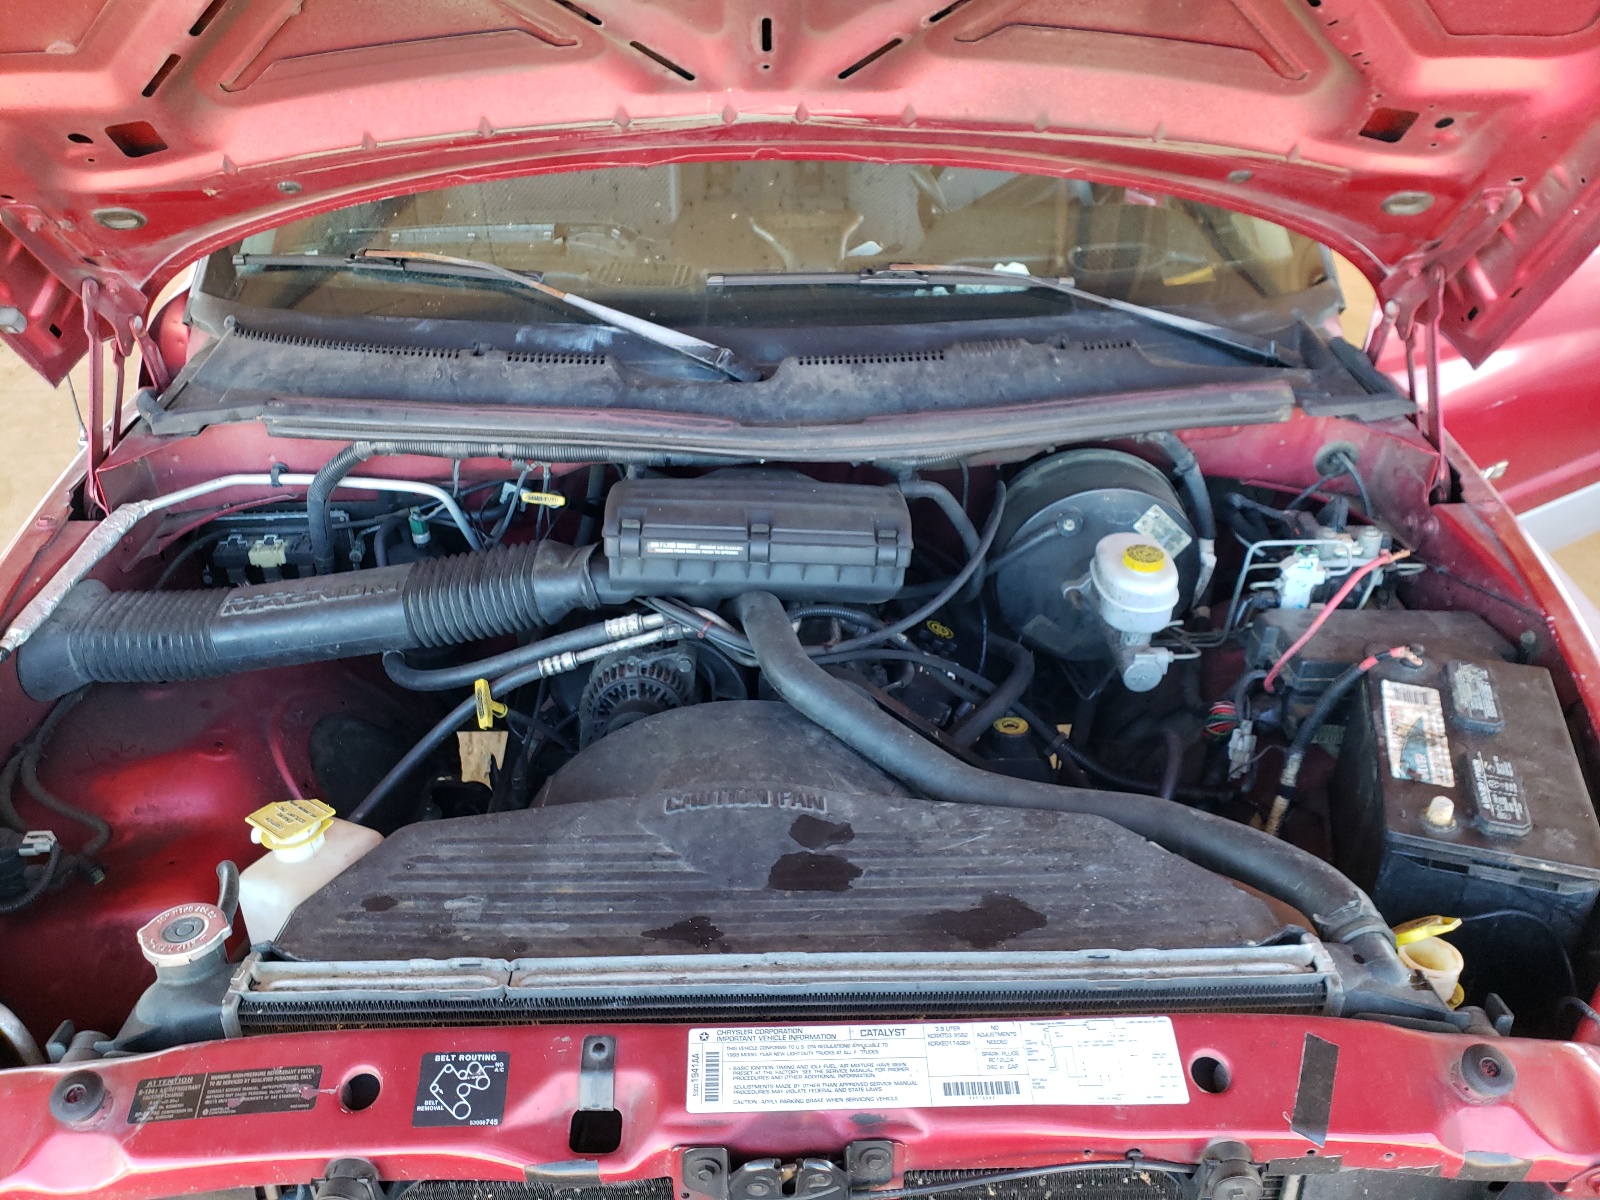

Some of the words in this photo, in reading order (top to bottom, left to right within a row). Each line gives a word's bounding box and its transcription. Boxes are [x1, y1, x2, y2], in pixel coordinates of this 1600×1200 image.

[778, 790, 828, 814] FAN
[860, 1028, 906, 1037] CATALYST
[146, 1076, 194, 1086] ATTENTION
